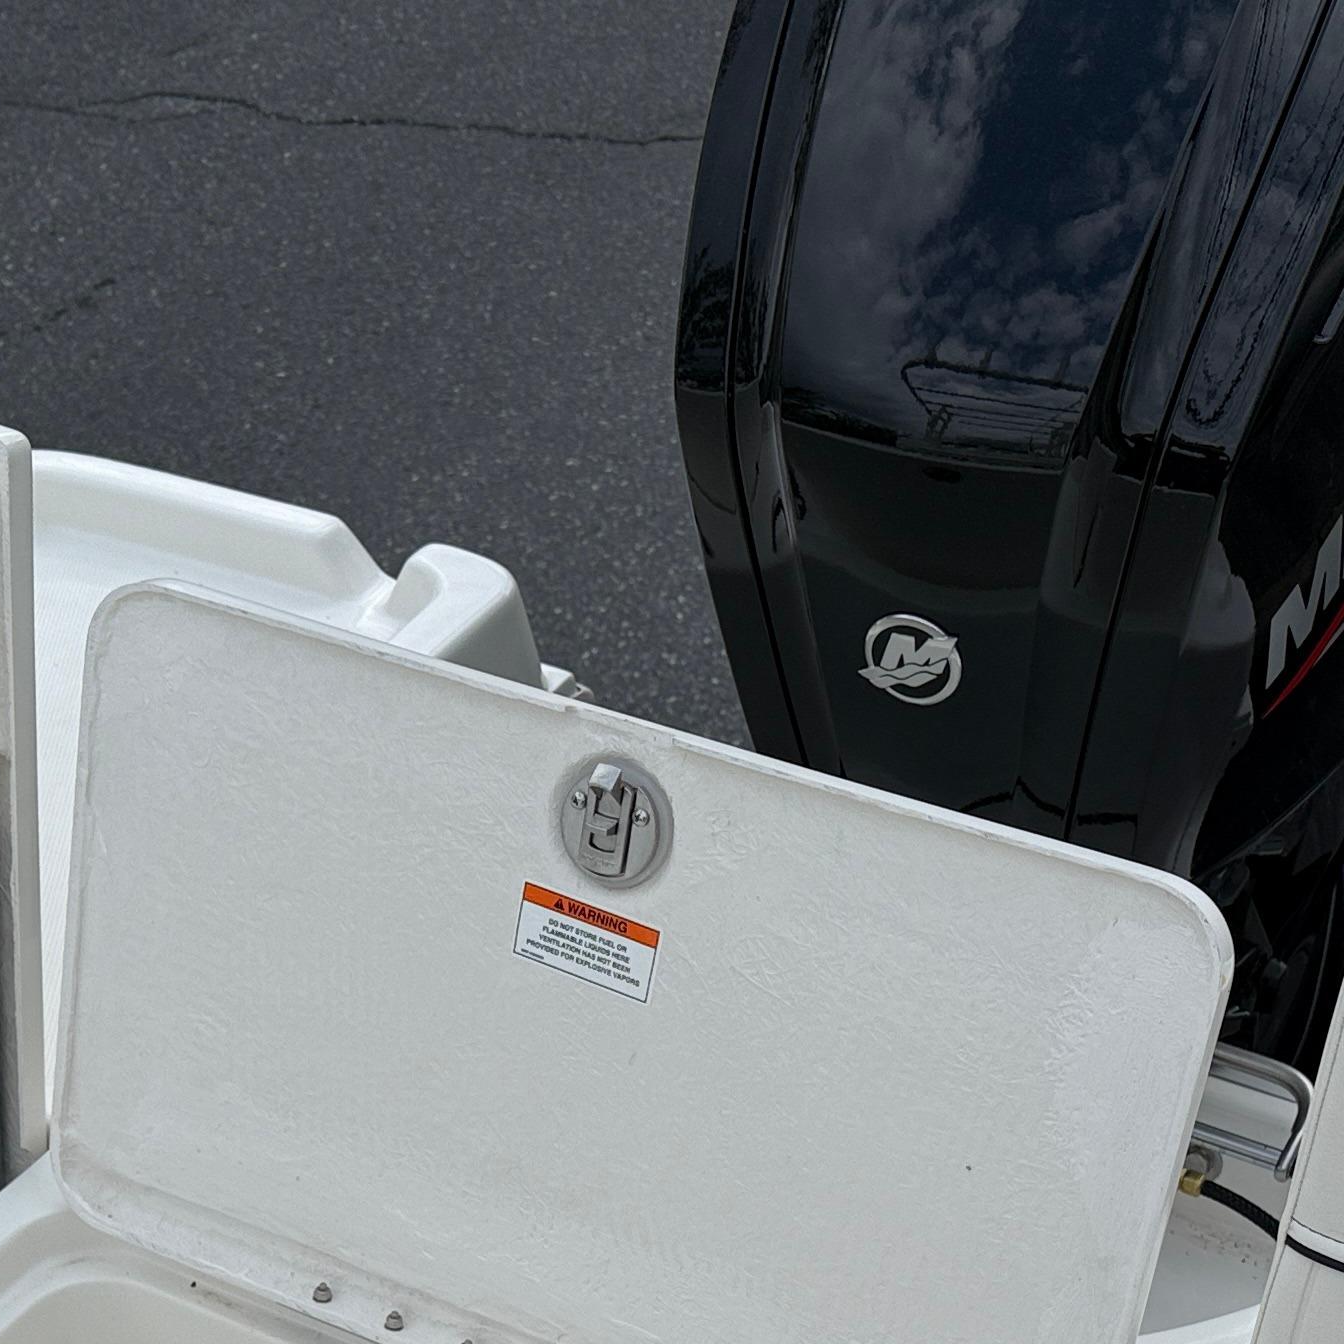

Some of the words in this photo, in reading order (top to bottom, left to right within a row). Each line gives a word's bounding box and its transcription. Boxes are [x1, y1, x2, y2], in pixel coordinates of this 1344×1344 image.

[548, 918, 558, 927] DO
[560, 923, 574, 933] NOT
[575, 928, 597, 942] STORE
[598, 937, 615, 949] FUEL
[616, 944, 627, 953] OR
[567, 902, 628, 934] WARNING
[526, 938, 559, 956] PROVIDED
[561, 951, 574, 962] FOR
[576, 957, 612, 976] EXPLOSIVE
[613, 971, 640, 987] VAPORS
[539, 934, 581, 955] VENTILATION
[582, 950, 596, 961] HAS
[597, 956, 611, 966] NOT
[612, 962, 631, 974] BEEN
[542, 926, 583, 946] FLAMMABLE
[584, 941, 610, 956] LIQUIDS
[611, 952, 630, 964] HERE
